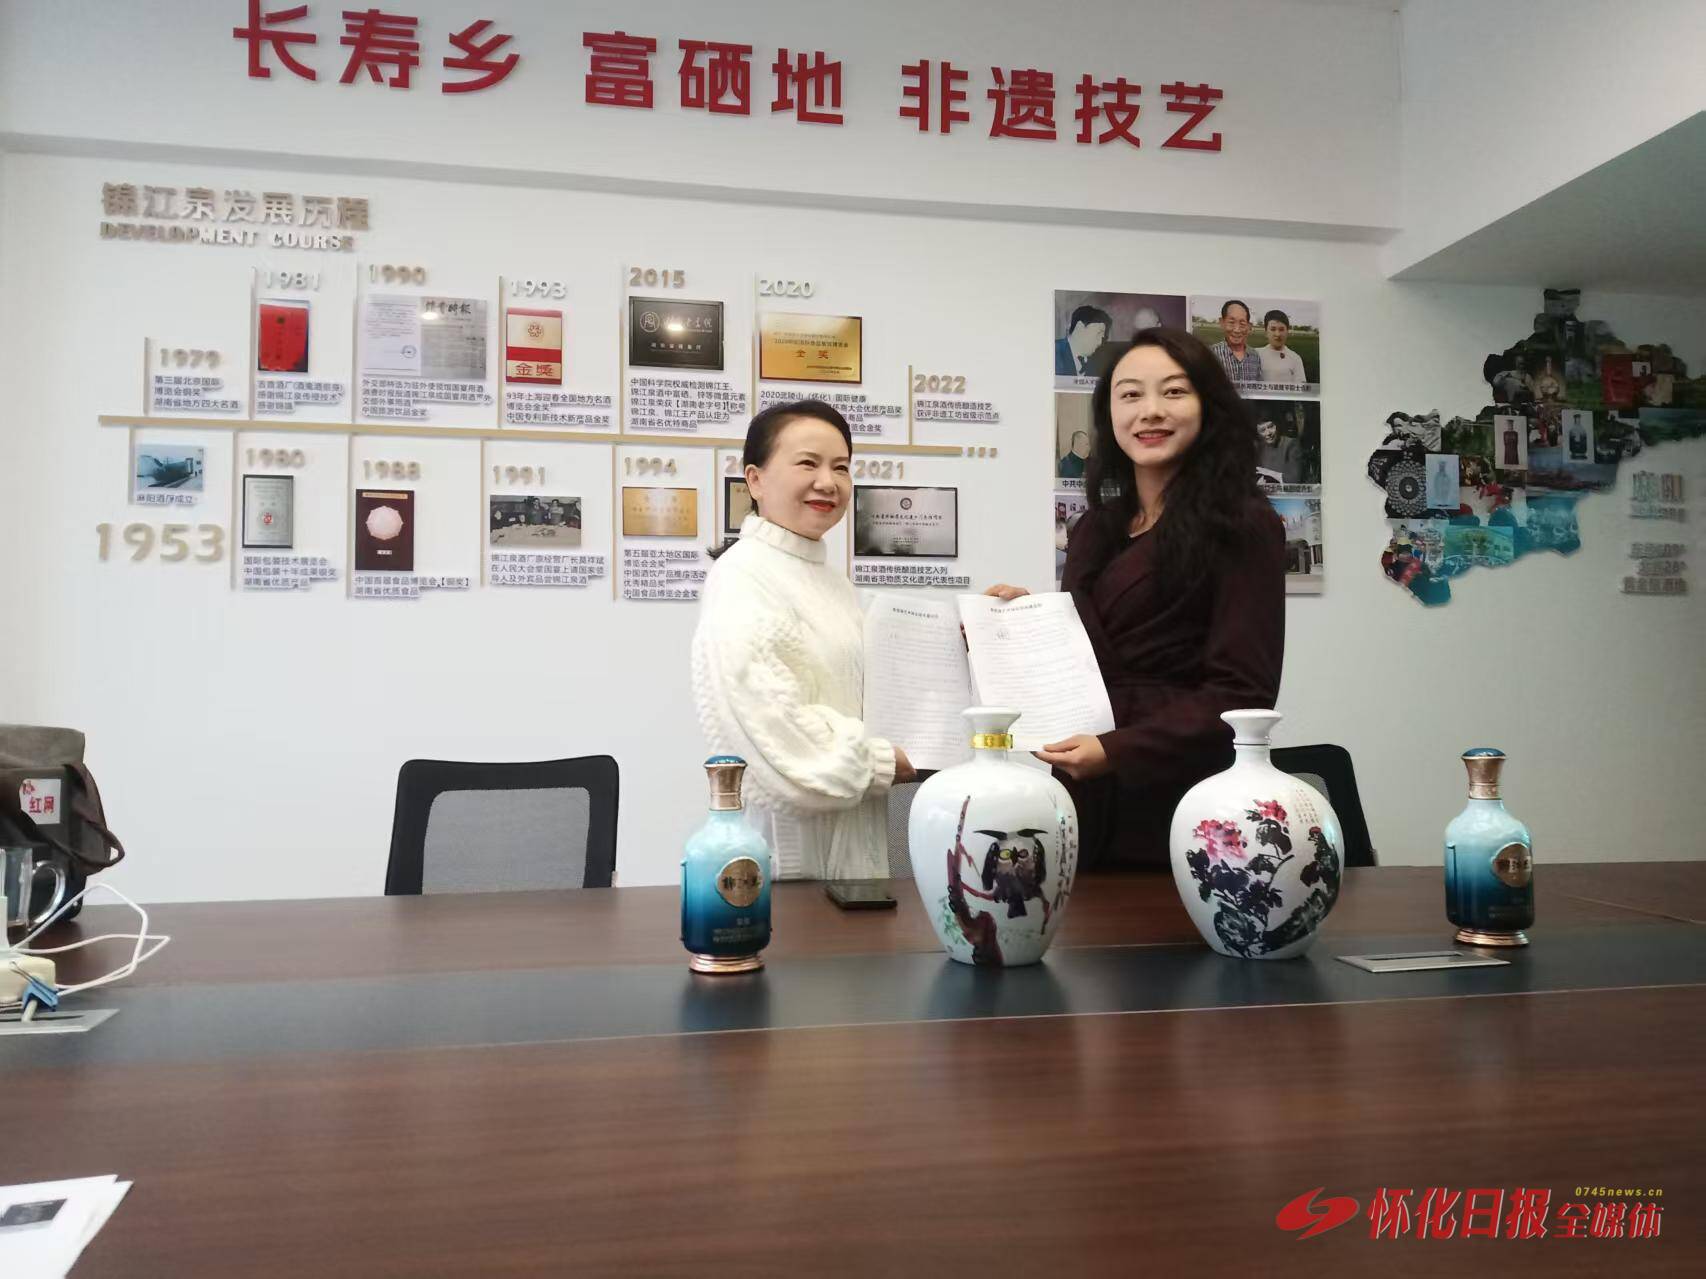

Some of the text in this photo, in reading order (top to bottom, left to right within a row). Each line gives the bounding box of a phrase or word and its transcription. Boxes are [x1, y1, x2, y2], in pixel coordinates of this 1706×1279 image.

[233, 0, 1224, 153] 长寿乡 富硒地 非遗技艺
[102, 182, 369, 231] 锦江泉发展历程
[100, 220, 258, 248] DEVELOPMENT
[264, 270, 322, 291] 1981
[368, 262, 428, 285] 1990
[629, 267, 686, 289] 2015
[509, 280, 567, 299] 1993
[759, 279, 816, 298] 2020
[160, 348, 221, 369] 1979
[914, 374, 967, 394] 2022
[246, 448, 305, 468] 1980
[363, 459, 421, 481] 1988
[492, 465, 546, 486] 1991
[854, 460, 905, 480] 2021
[96, 522, 226, 563] 1953
